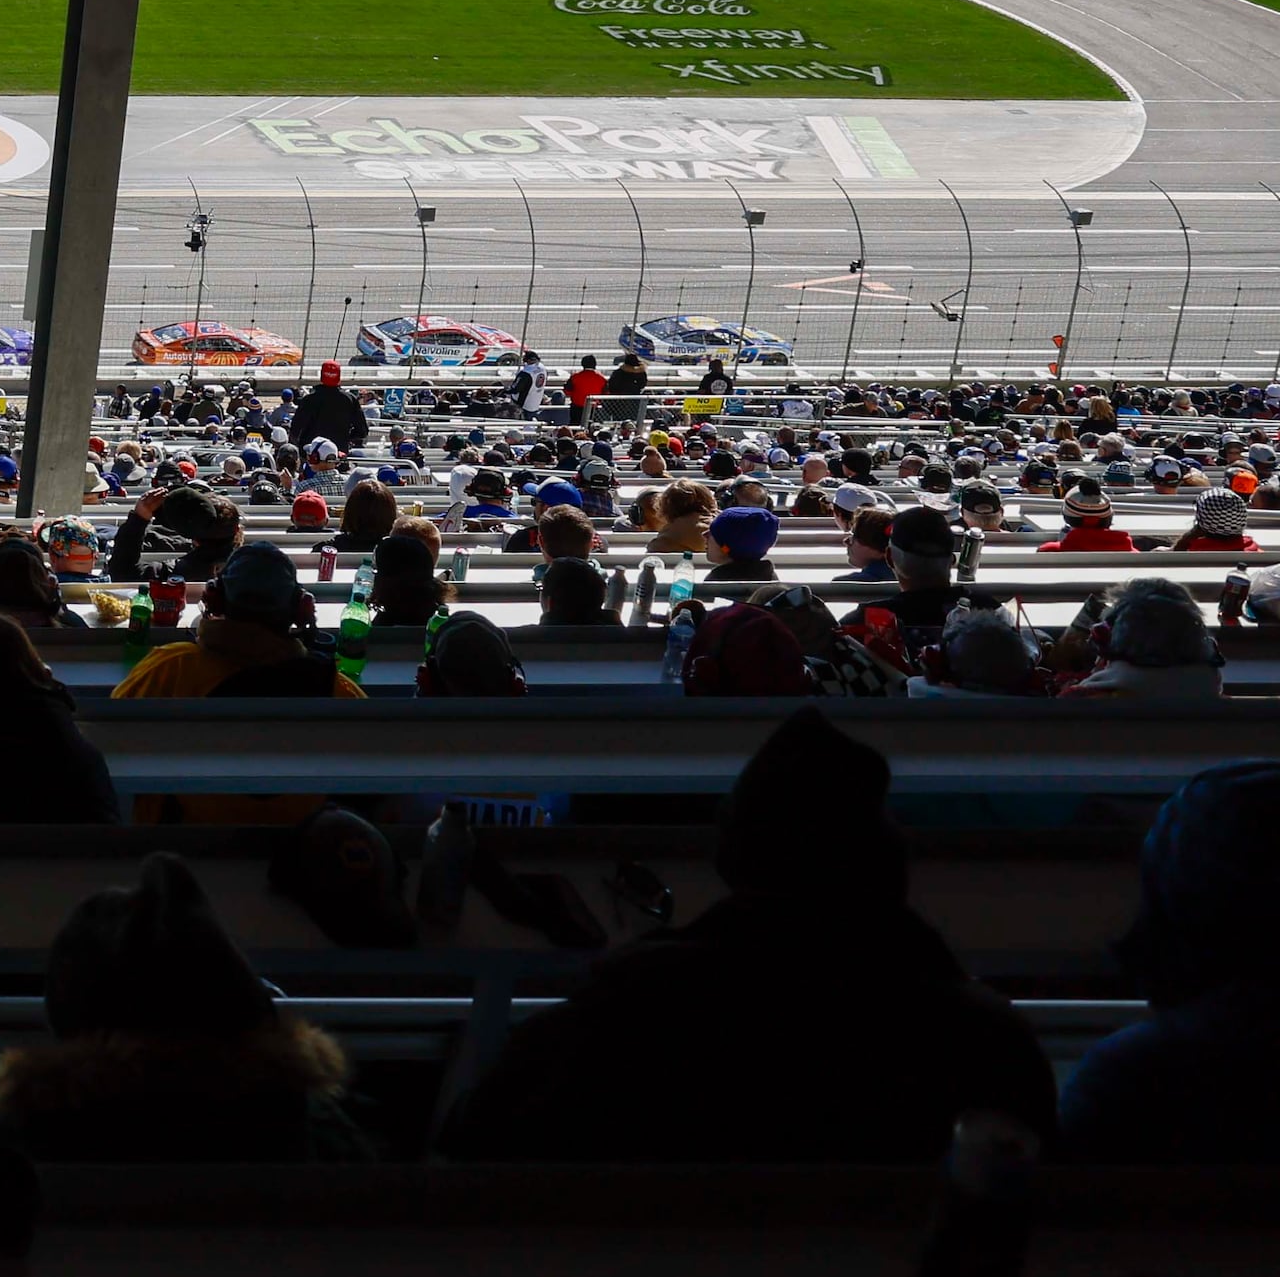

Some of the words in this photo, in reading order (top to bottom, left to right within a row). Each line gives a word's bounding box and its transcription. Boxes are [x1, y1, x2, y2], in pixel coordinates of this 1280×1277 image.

[598, 25, 810, 45] Freeway
[626, 42, 829, 50] INSURANCE
[660, 58, 888, 87] xfinity
[246, 114, 805, 157] EchoPark
[348, 158, 790, 182] SPEEDWAY
[162, 352, 206, 361] Autotrder
[414, 345, 460, 357] Valvoline
[467, 346, 486, 364] 5
[668, 345, 687, 354] AUTO
[688, 345, 707, 354] PARTS
